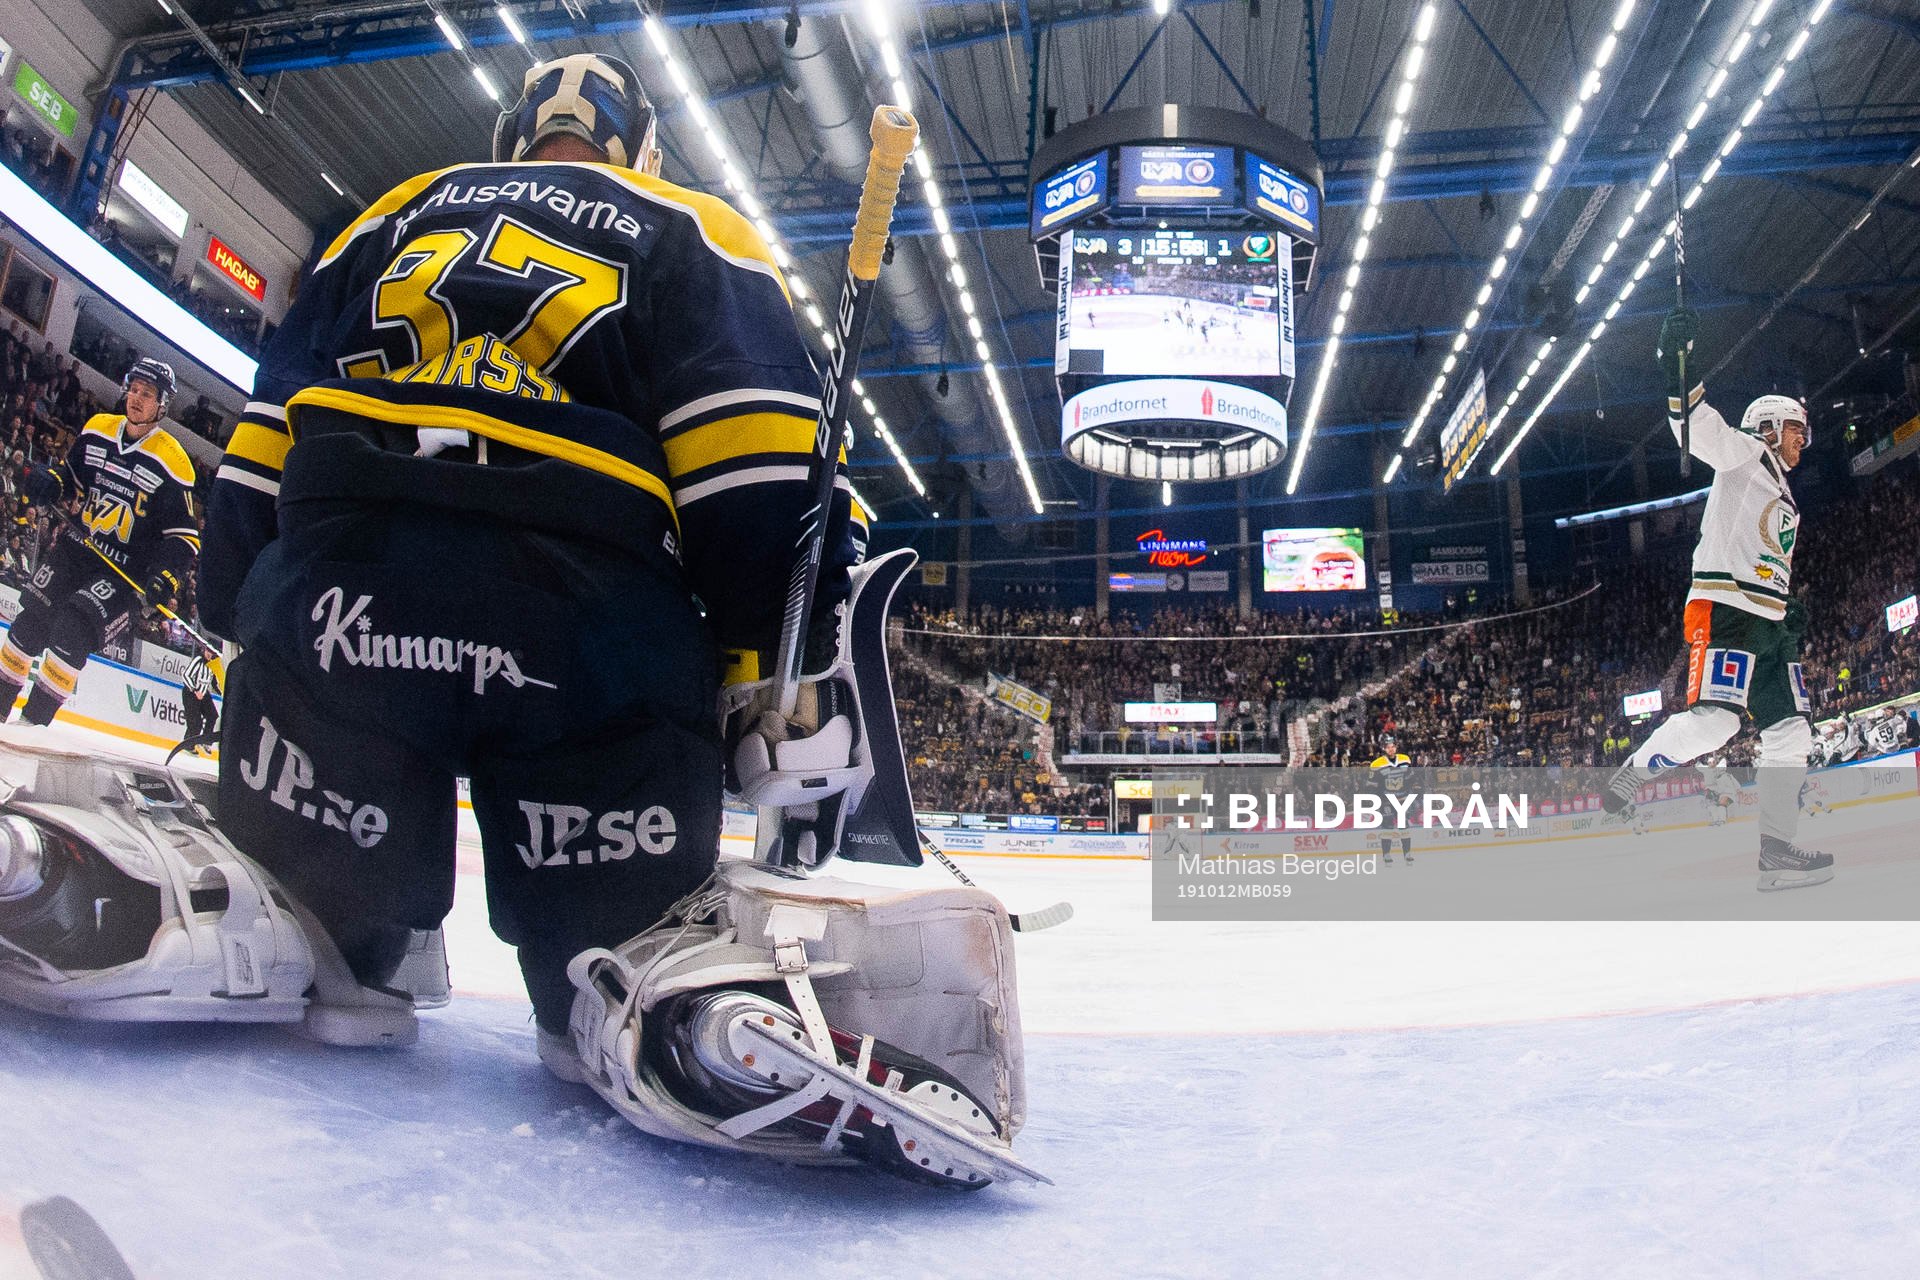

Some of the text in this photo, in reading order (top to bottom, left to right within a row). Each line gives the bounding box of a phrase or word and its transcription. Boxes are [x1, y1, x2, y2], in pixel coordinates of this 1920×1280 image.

[29, 81, 63, 121] SEB
[392, 180, 642, 250] Husqvarna
[1118, 239, 1132, 255] 3
[1218, 240, 1232, 256] 1
[215, 247, 259, 291] HAGAB
[337, 213, 628, 378] 37
[385, 331, 570, 403] ARSS
[1082, 397, 1167, 421] Brandtornet
[1139, 541, 1207, 551] LINNMANS
[1427, 563, 1488, 577] MR. BBQ
[311, 586, 558, 695] Kinnarps
[1879, 726, 1894, 743] 59
[240, 715, 389, 849] JP.se
[1873, 769, 1900, 787] Hydro
[1129, 783, 1189, 796] Scandic
[1448, 828, 1481, 837] HECO
[1552, 817, 1593, 832] SUBWAY
[514, 799, 677, 870] JP.se
[944, 837, 984, 845] TROAX
[1293, 835, 1329, 847] SEW
[1000, 839, 1048, 848] JUNET
[1234, 840, 1260, 849] Kitron
